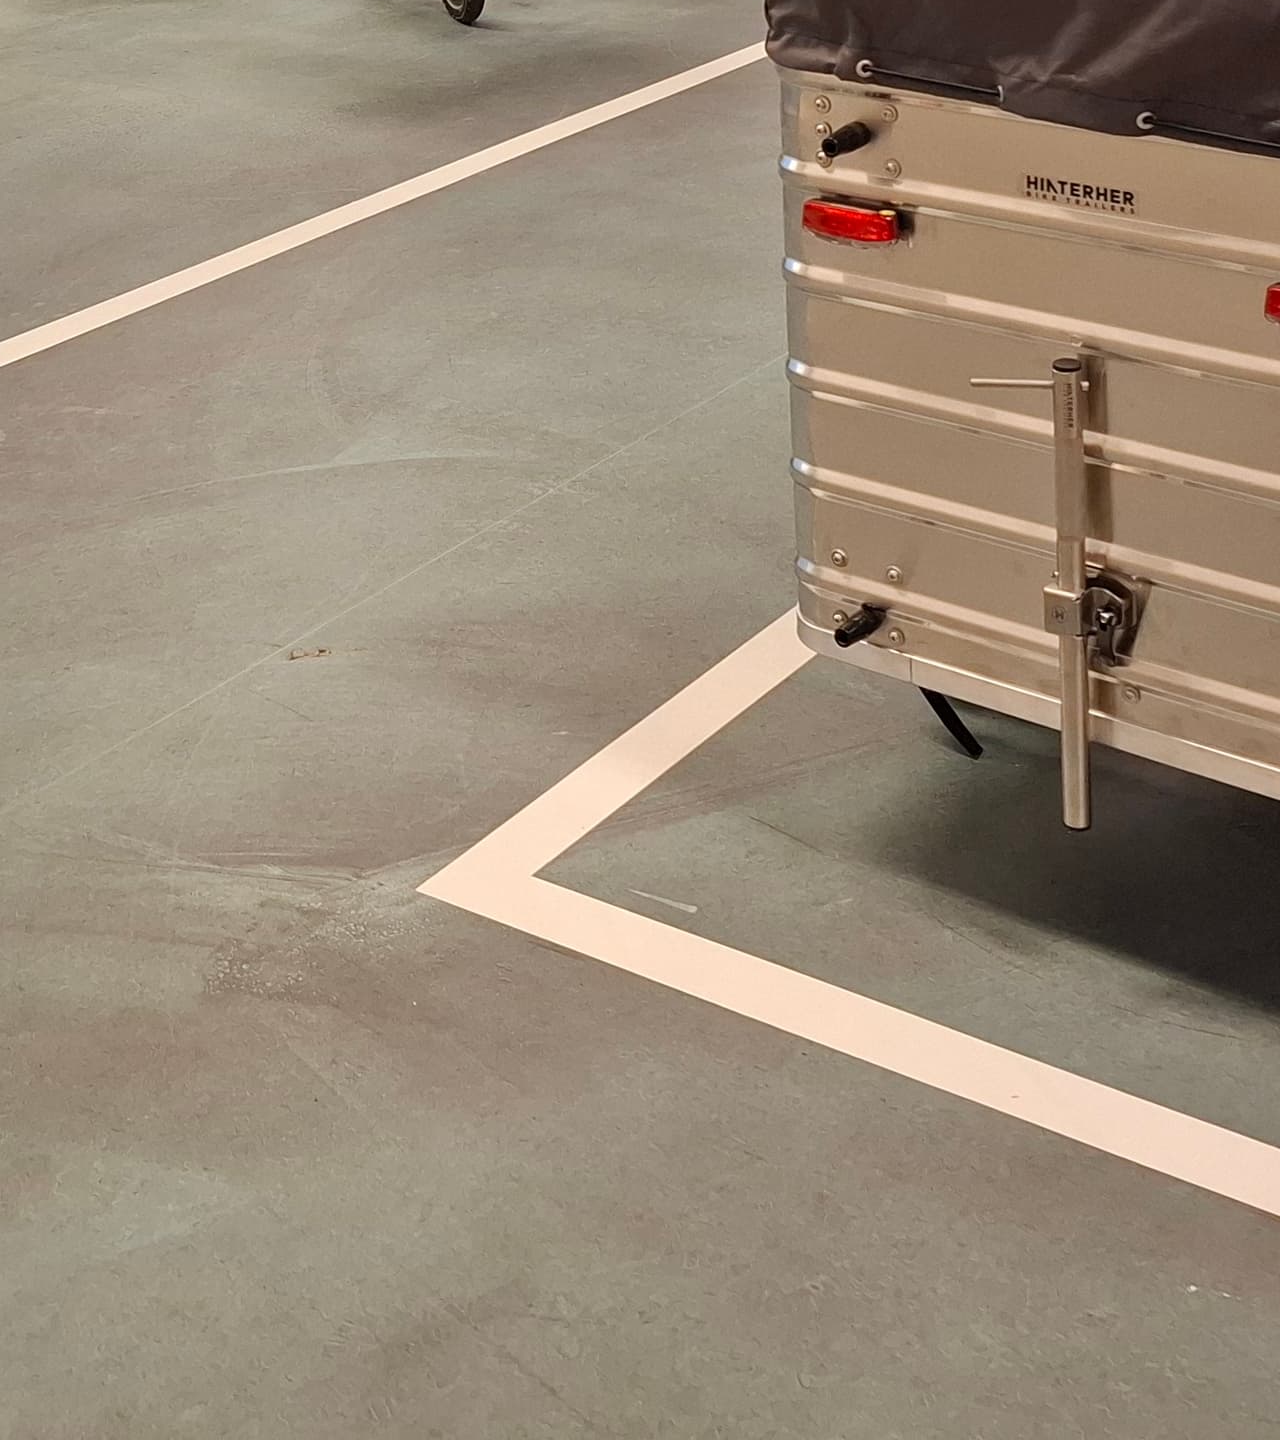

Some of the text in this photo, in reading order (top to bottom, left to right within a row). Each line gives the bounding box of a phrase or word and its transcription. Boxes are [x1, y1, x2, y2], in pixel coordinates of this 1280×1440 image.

[1026, 175, 1135, 207] HINTERHER
[1026, 191, 1135, 215] BIKE TRAILERS
